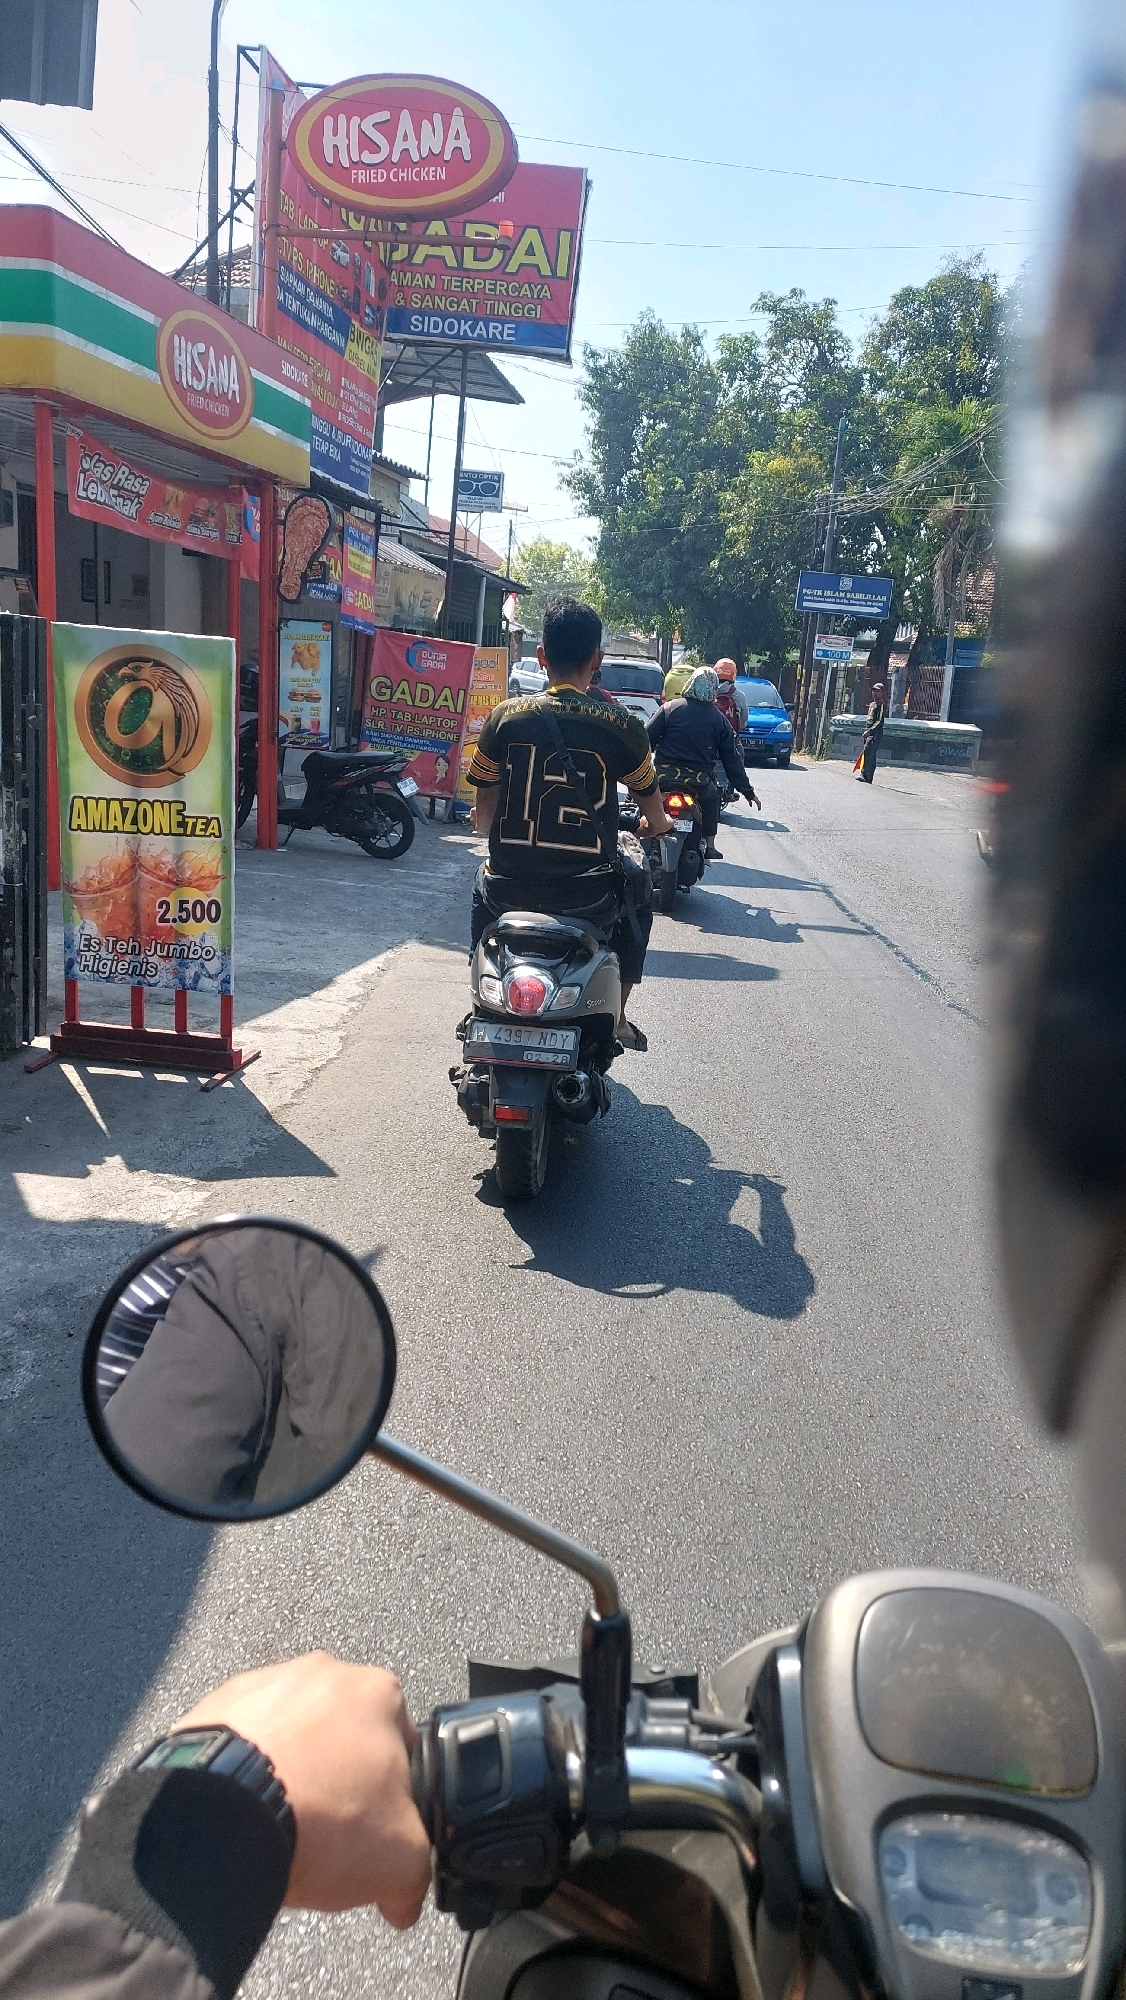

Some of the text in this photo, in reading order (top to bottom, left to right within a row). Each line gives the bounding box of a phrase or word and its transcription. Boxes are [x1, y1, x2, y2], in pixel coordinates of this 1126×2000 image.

[323, 107, 472, 168] HISANA
[351, 166, 446, 184] FRIED CHICKEN
[391, 269, 552, 299] AMAN TERPERCAYA
[394, 292, 542, 319] & SANGAT TINGGI
[410, 315, 516, 342] SIDOKARE
[173, 334, 240, 404] HISANA
[187, 392, 230, 418] FRIED CHICKEN
[113, 467, 150, 495] Rasa
[421, 659, 446, 671] GADAI
[422, 650, 447, 661] DUNIA
[827, 650, 841, 659] 100
[370, 675, 465, 714] GADAI
[365, 718, 387, 730] SLR.
[371, 707, 387, 718] HP.
[499, 743, 608, 855] 12
[71, 797, 221, 838] AMAZONE TEA
[157, 897, 222, 926] 2.500
[79, 935, 216, 962] Es Teh Jumbo
[79, 950, 159, 979] Higienis
[494, 1027, 533, 1043] 4397
